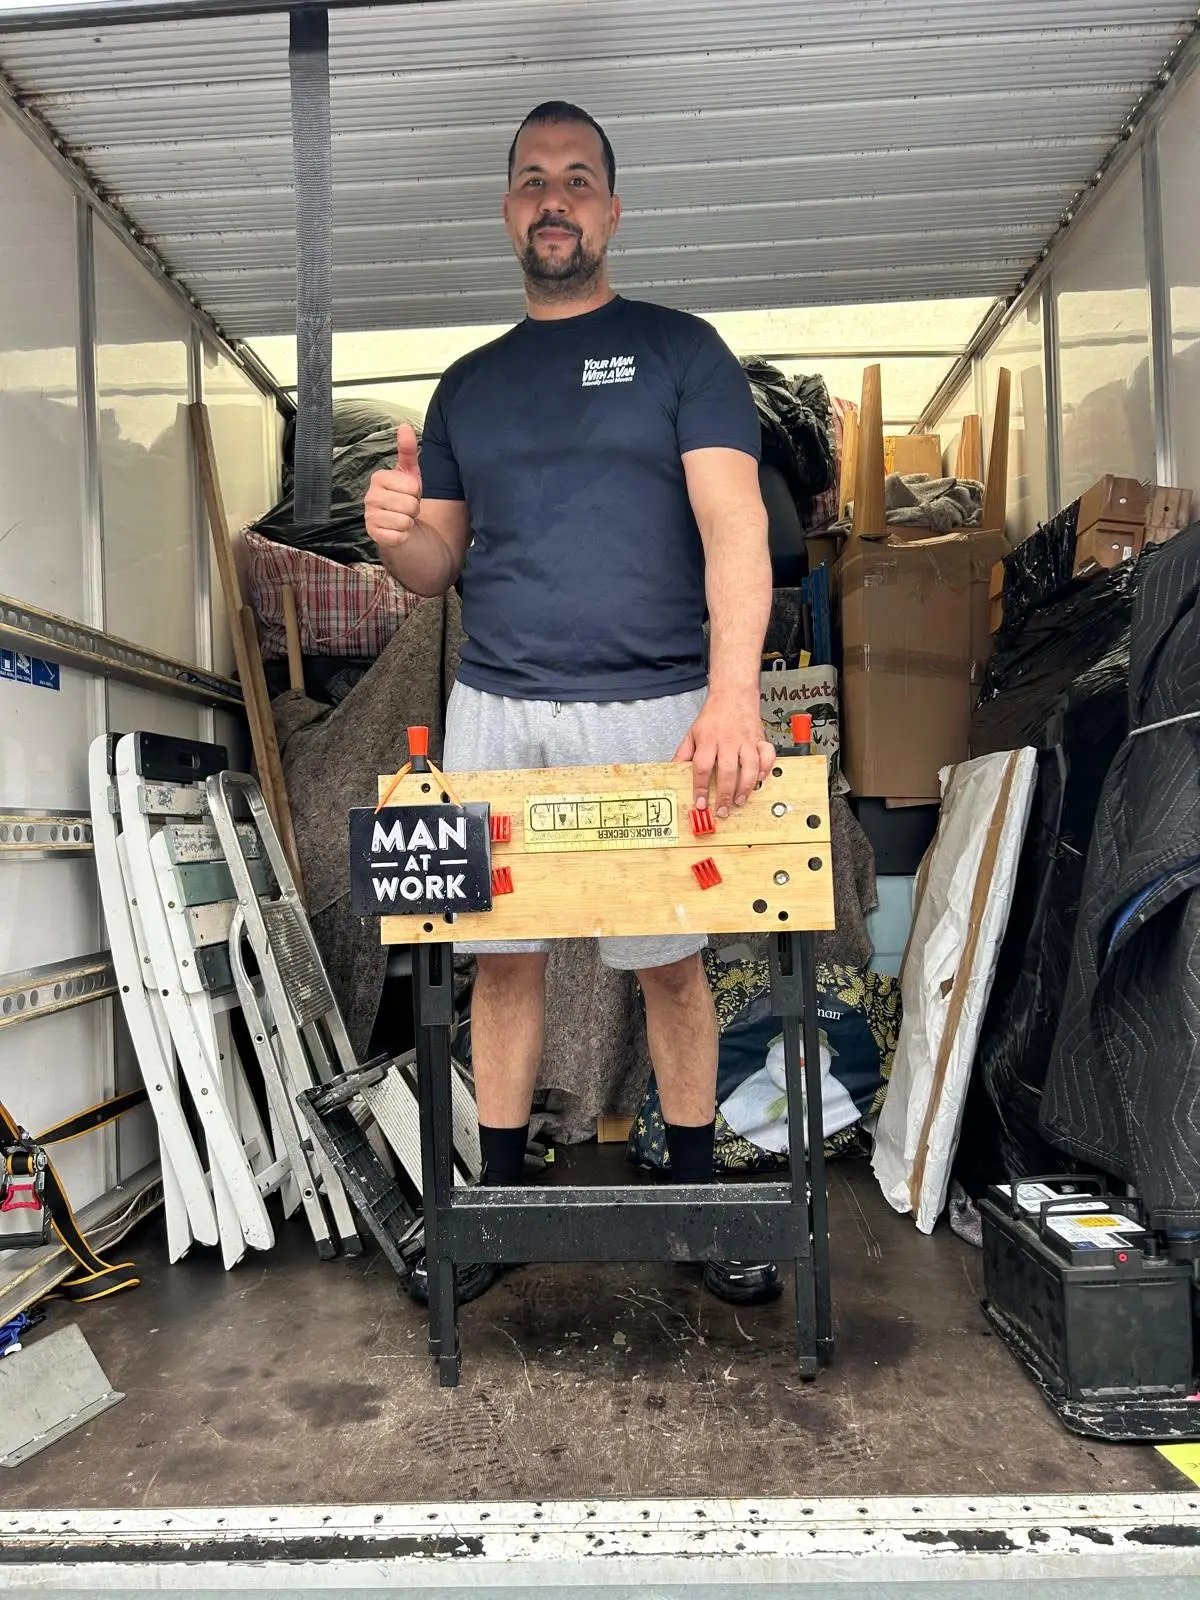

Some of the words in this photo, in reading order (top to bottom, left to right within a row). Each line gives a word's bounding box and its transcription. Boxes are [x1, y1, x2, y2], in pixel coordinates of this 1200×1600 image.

[584, 359, 610, 371] YOUR
[609, 356, 634, 368] MAN
[582, 370, 608, 382] WITH
[607, 370, 615, 379] A
[615, 366, 636, 378] VAN
[371, 816, 467, 853] MAN
[404, 853, 432, 872] AT
[371, 873, 468, 902] WORK
